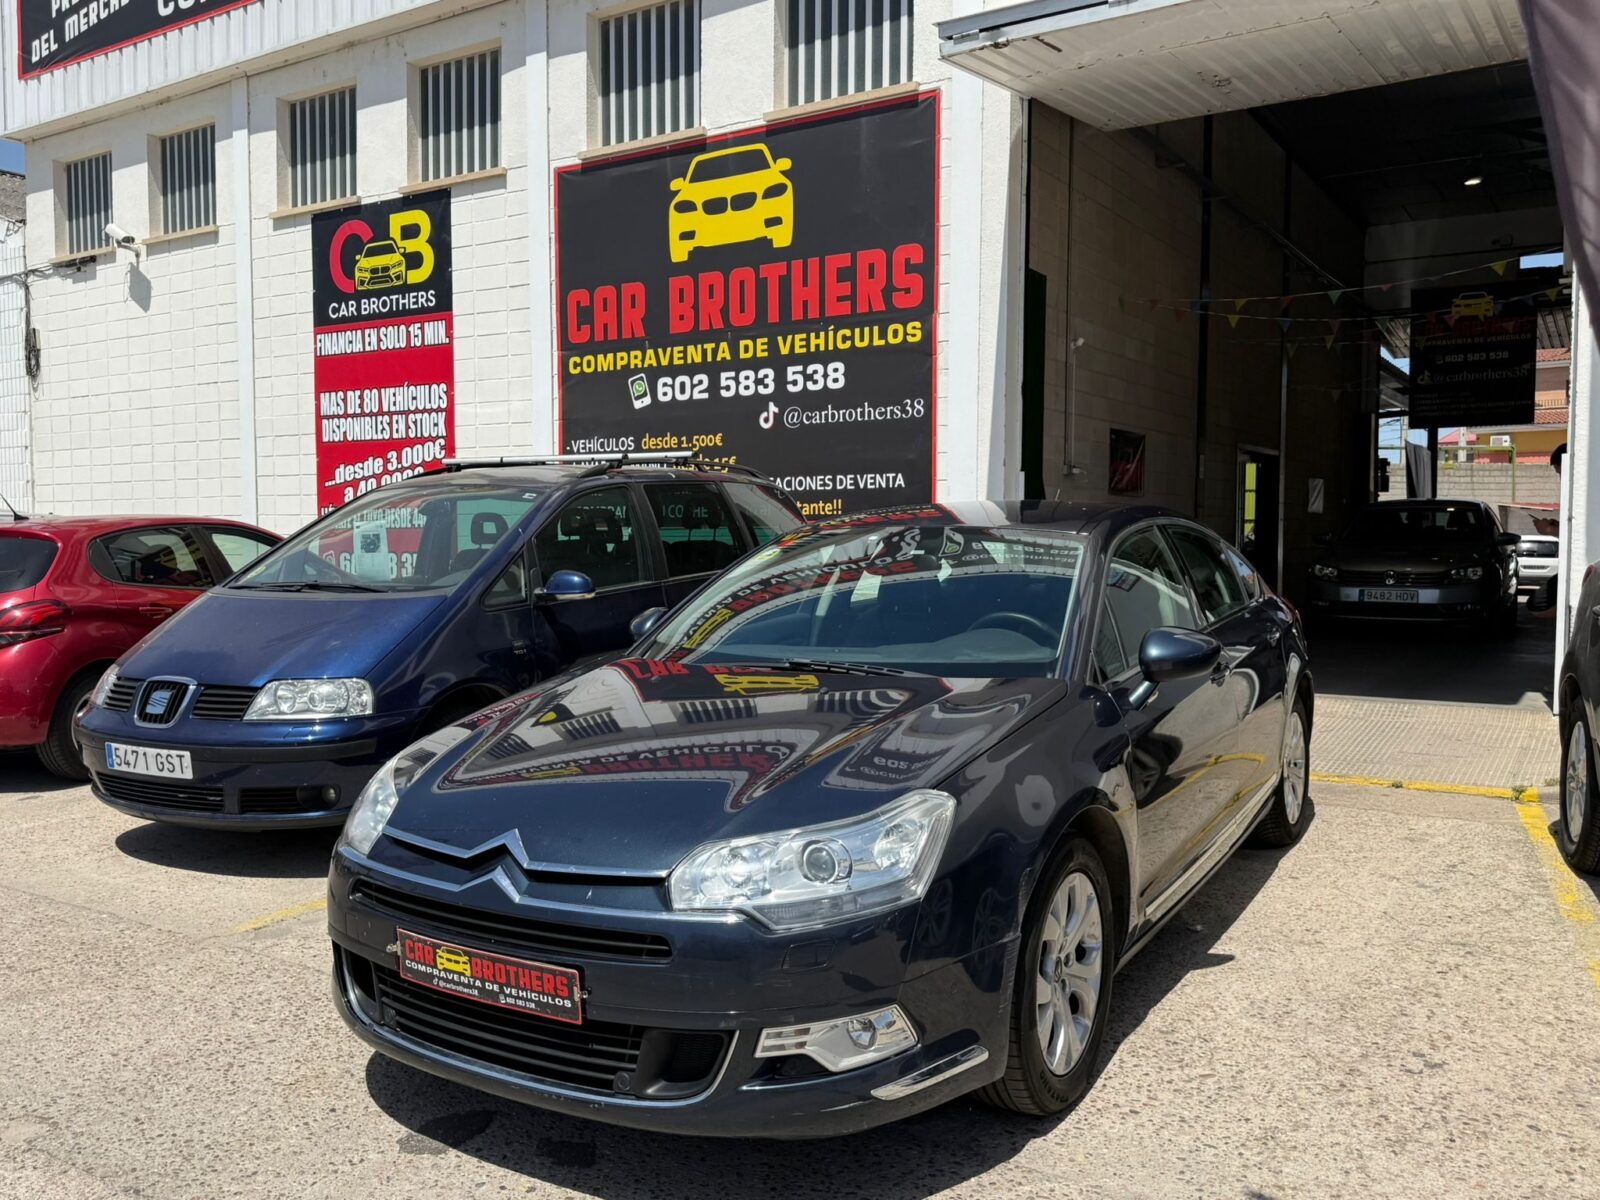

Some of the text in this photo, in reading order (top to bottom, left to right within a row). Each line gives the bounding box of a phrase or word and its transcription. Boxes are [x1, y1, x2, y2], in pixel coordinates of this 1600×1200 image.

[31, 29, 58, 63] DEL
[328, 290, 436, 319] CAR BROTHERS
[567, 242, 925, 345] CAR BROTHERS
[316, 319, 449, 357] FINANCIA EN SOLO 15 MIN.
[568, 320, 923, 375] COMPRAVENTA DE VEHÍCULOS
[656, 361, 846, 402] 602 583 538
[320, 381, 448, 417] MAS DE 80 VEHÍCULOS
[783, 398, 925, 429] @carbrothers38
[321, 410, 447, 443] DISPONIBLES EN STOCK
[641, 432, 679, 451] desde
[681, 433, 723, 452] 1.500€
[387, 438, 447, 472] 3.000€
[768, 473, 906, 491] ACIONES DE VENTA
[1366, 591, 1416, 601] 9482 HDV
[114, 747, 186, 775] 5471 GST
[405, 938, 569, 998] CAR BROTHERS
[405, 959, 572, 1008] COMPRAVENTA DE VEHÍCULOS
